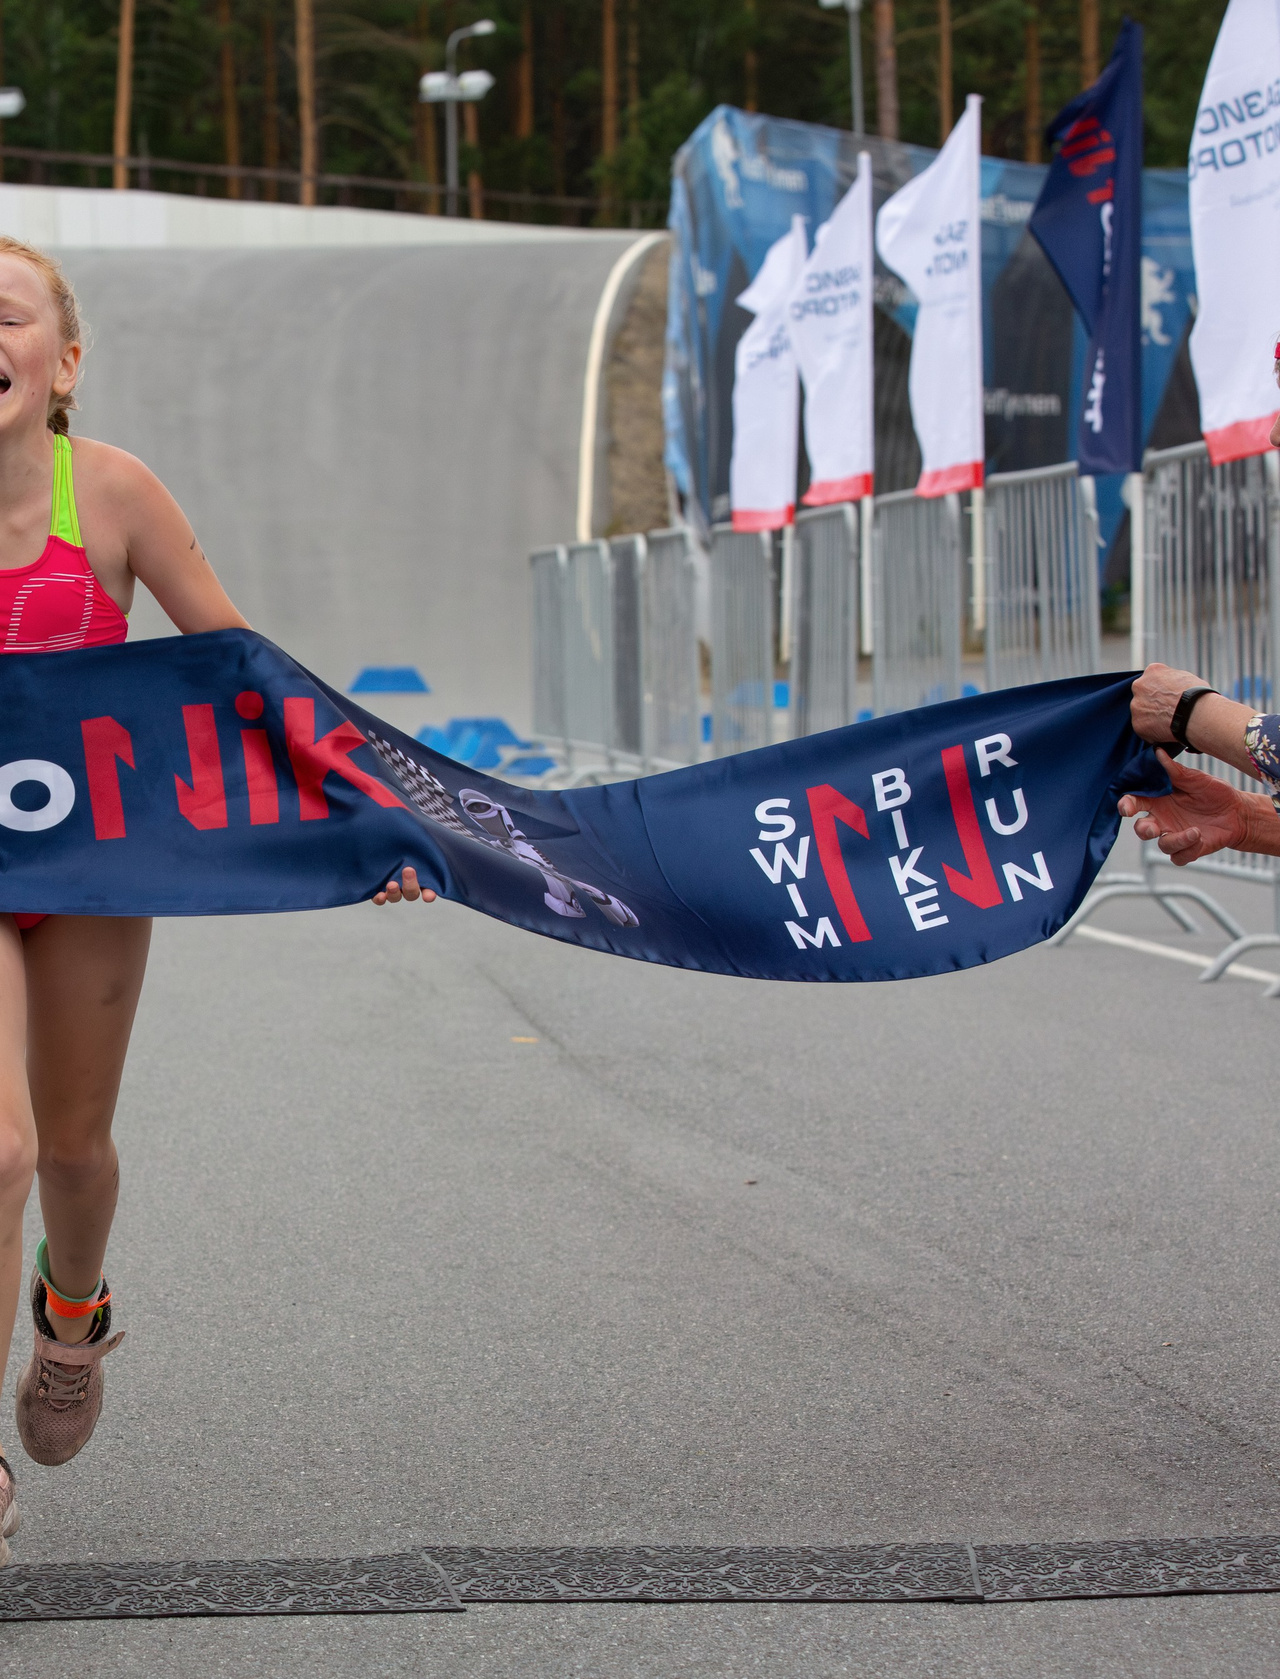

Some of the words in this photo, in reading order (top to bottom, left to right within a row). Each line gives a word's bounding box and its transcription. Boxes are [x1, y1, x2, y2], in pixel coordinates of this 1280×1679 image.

[749, 798, 842, 950] SWIM
[871, 767, 950, 932] BIKE
[974, 732, 1055, 902] RUN
